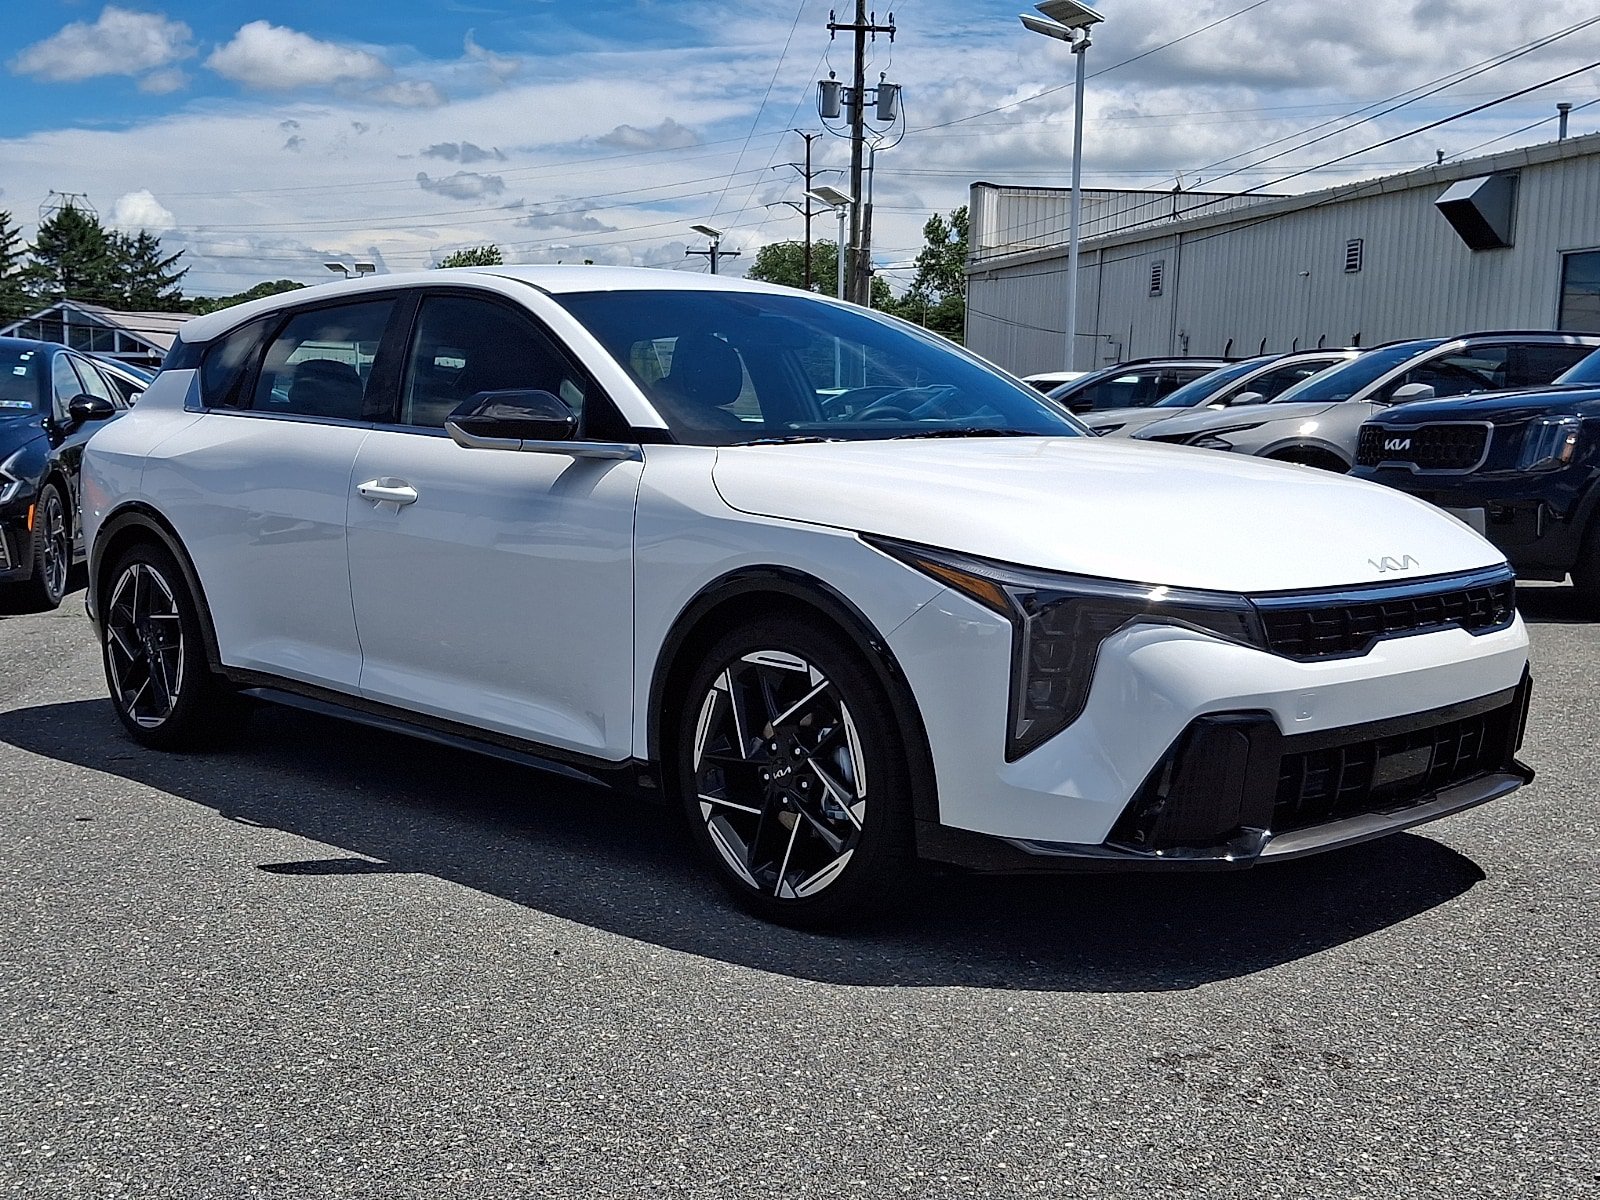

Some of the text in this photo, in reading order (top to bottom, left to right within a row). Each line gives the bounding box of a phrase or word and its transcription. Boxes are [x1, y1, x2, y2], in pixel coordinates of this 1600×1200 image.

[1385, 438, 1411, 450] KIA
[1368, 554, 1419, 573] KIA
[773, 766, 791, 779] KIA
